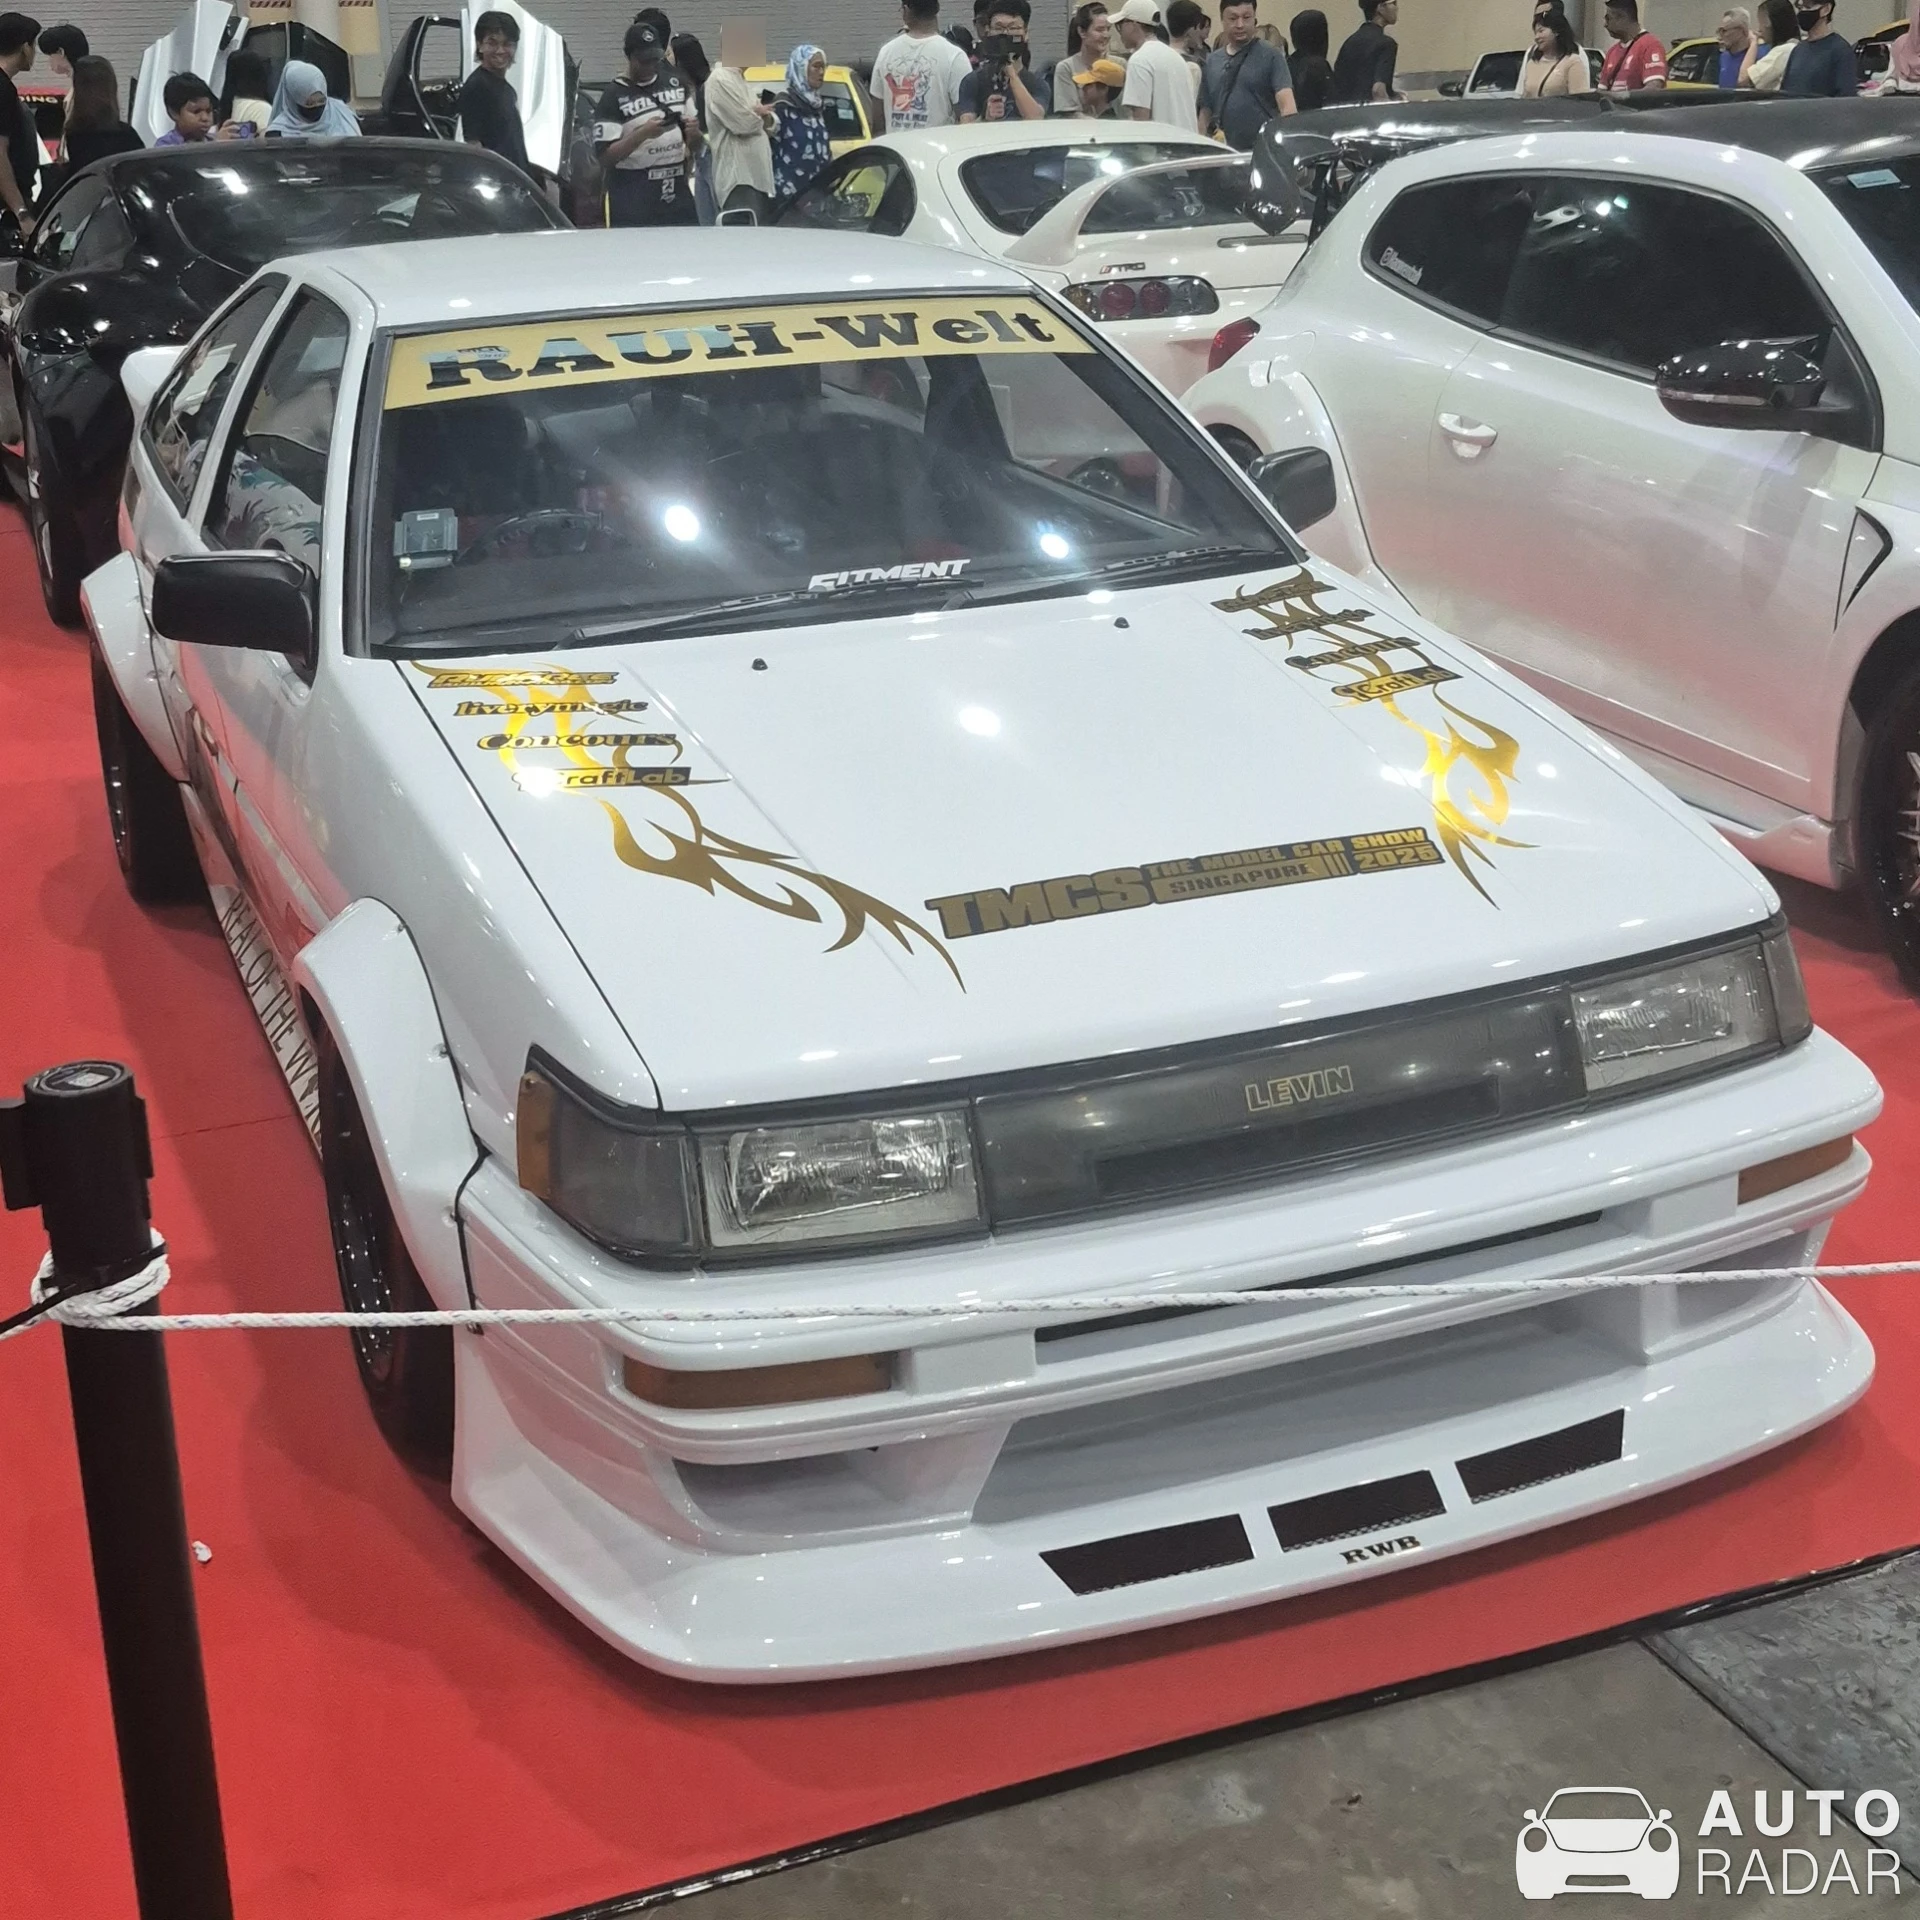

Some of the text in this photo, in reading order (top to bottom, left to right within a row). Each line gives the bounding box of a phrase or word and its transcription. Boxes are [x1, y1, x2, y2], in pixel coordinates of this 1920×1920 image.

[423, 310, 1056, 390] RAUH-Welt
[808, 559, 971, 592] FITMENT
[478, 734, 677, 749] Concours
[556, 768, 688, 785] raftLab
[1146, 829, 1425, 879] THE MODEL CAR SHOW
[1169, 844, 1440, 895] SINGAPORE 2025
[928, 868, 1150, 938] TMCS
[1244, 1065, 1355, 1112] LEVIN
[1339, 1535, 1422, 1565] RWB
